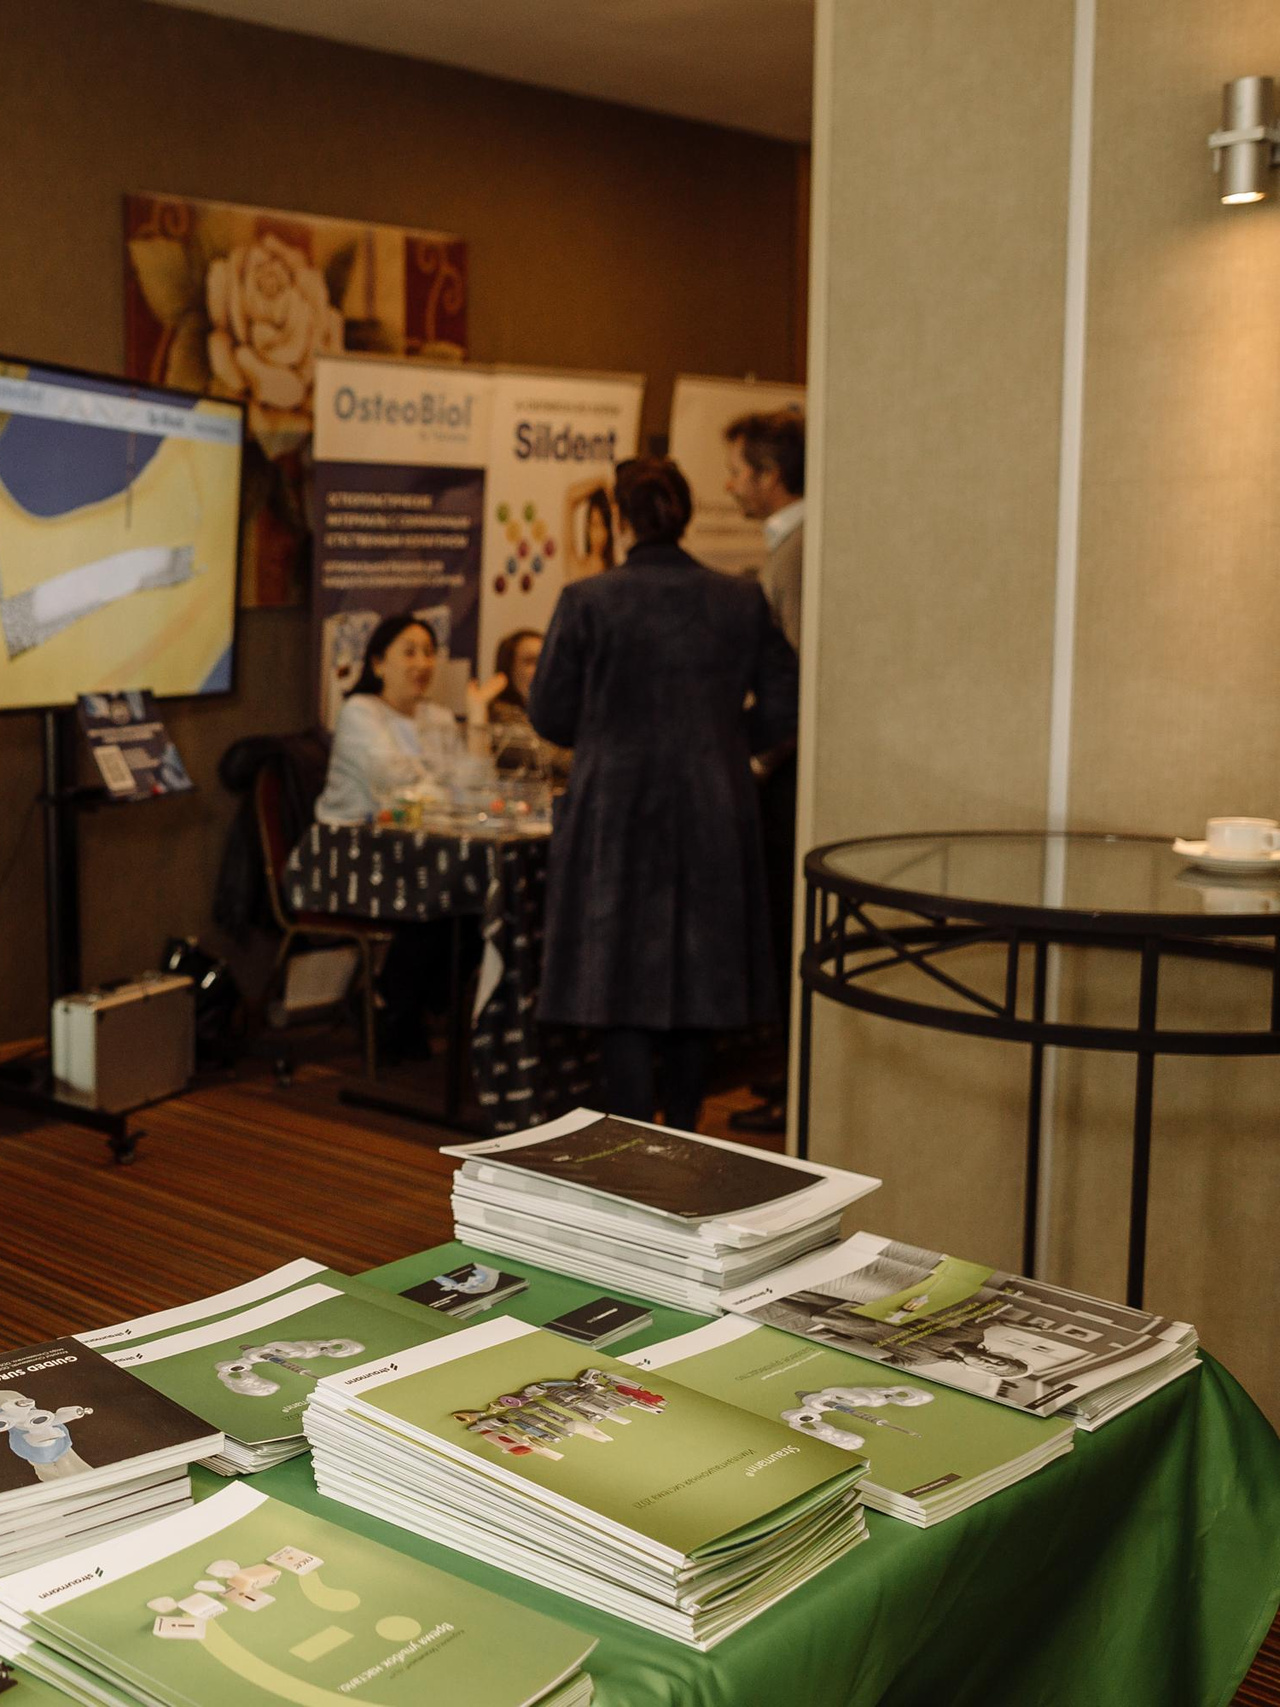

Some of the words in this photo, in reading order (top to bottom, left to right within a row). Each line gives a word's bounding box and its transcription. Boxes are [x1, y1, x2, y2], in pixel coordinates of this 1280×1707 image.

[334, 386, 474, 428] OsteoBiol
[514, 422, 617, 461] Sildent
[27, 1355, 78, 1373] GUIDED
[344, 1367, 390, 1385] straumann
[745, 1444, 801, 1477] Straumann®
[38, 1573, 94, 1599] straumann
[417, 1622, 455, 1646] Время
